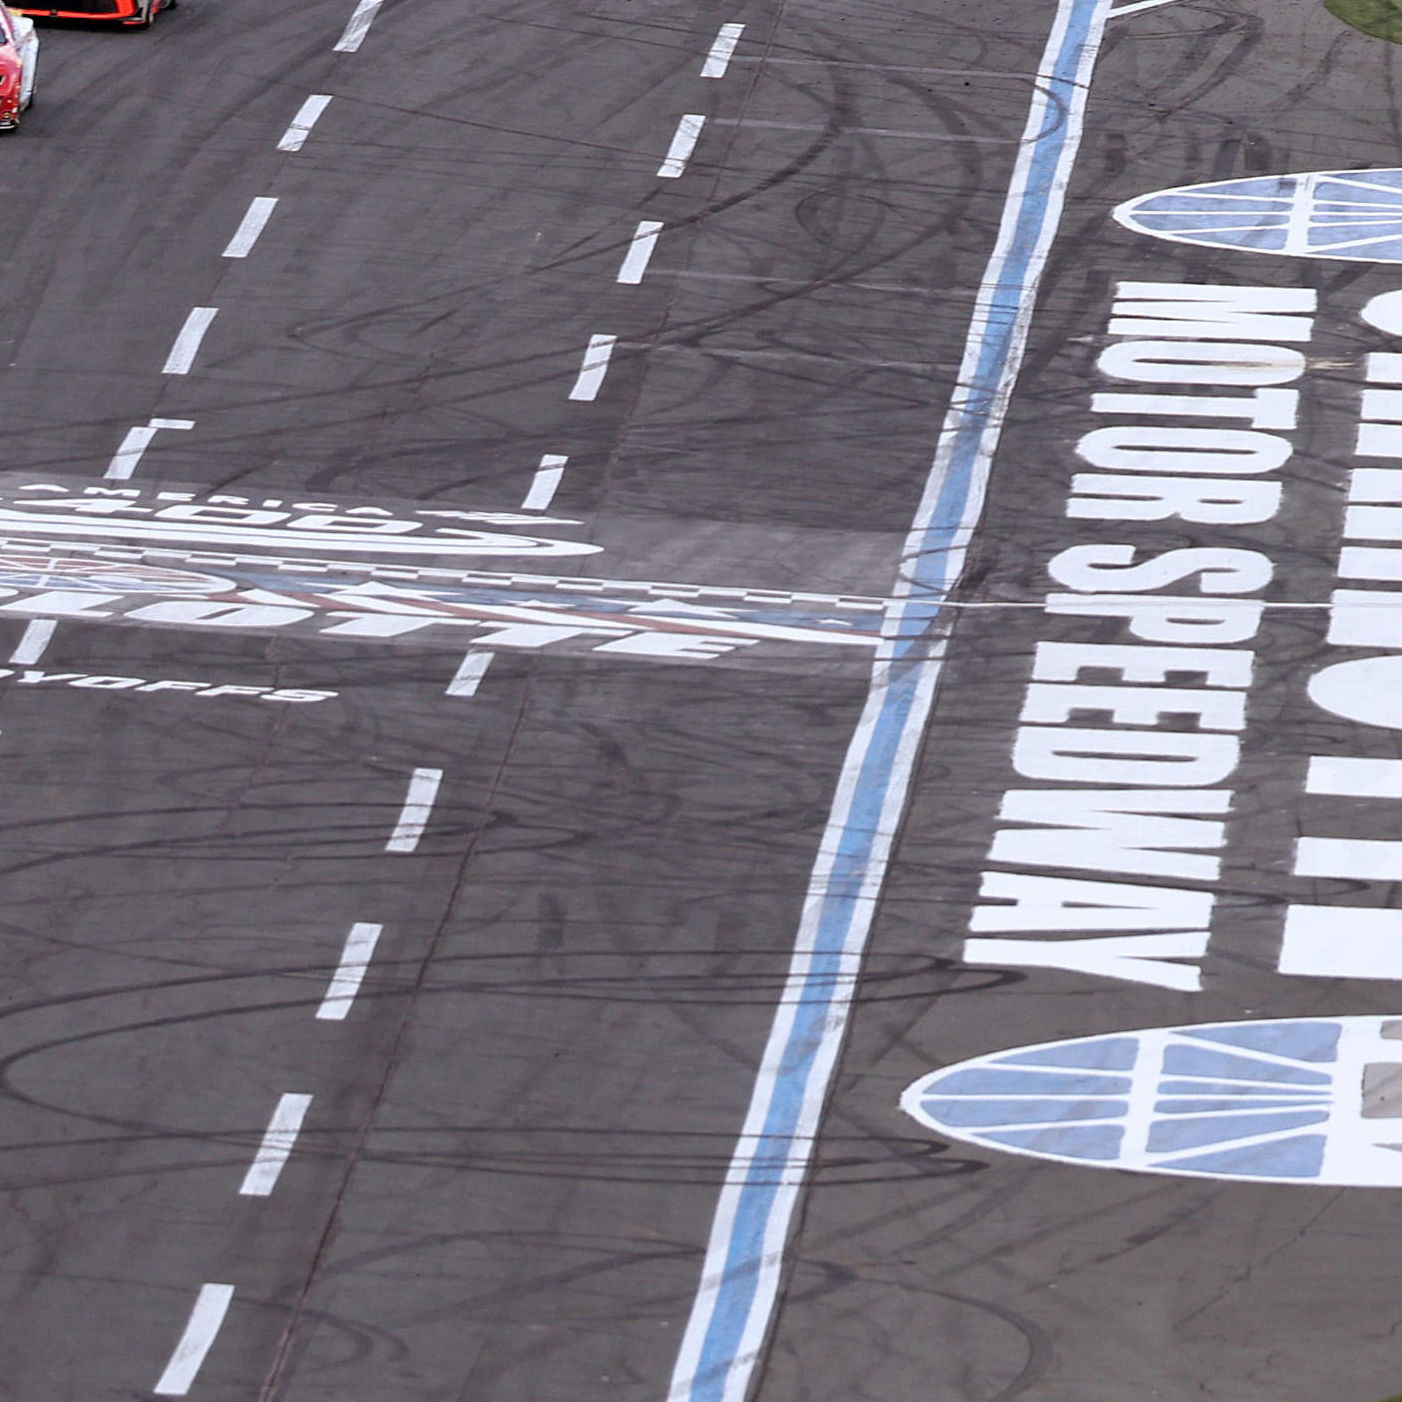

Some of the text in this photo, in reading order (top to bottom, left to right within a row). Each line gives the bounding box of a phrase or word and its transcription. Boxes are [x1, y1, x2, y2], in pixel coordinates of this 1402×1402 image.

[11, 498, 425, 535] 400
[19, 484, 396, 516] AMERICA
[963, 281, 1317, 991] MOTOR SPEEDWAY
